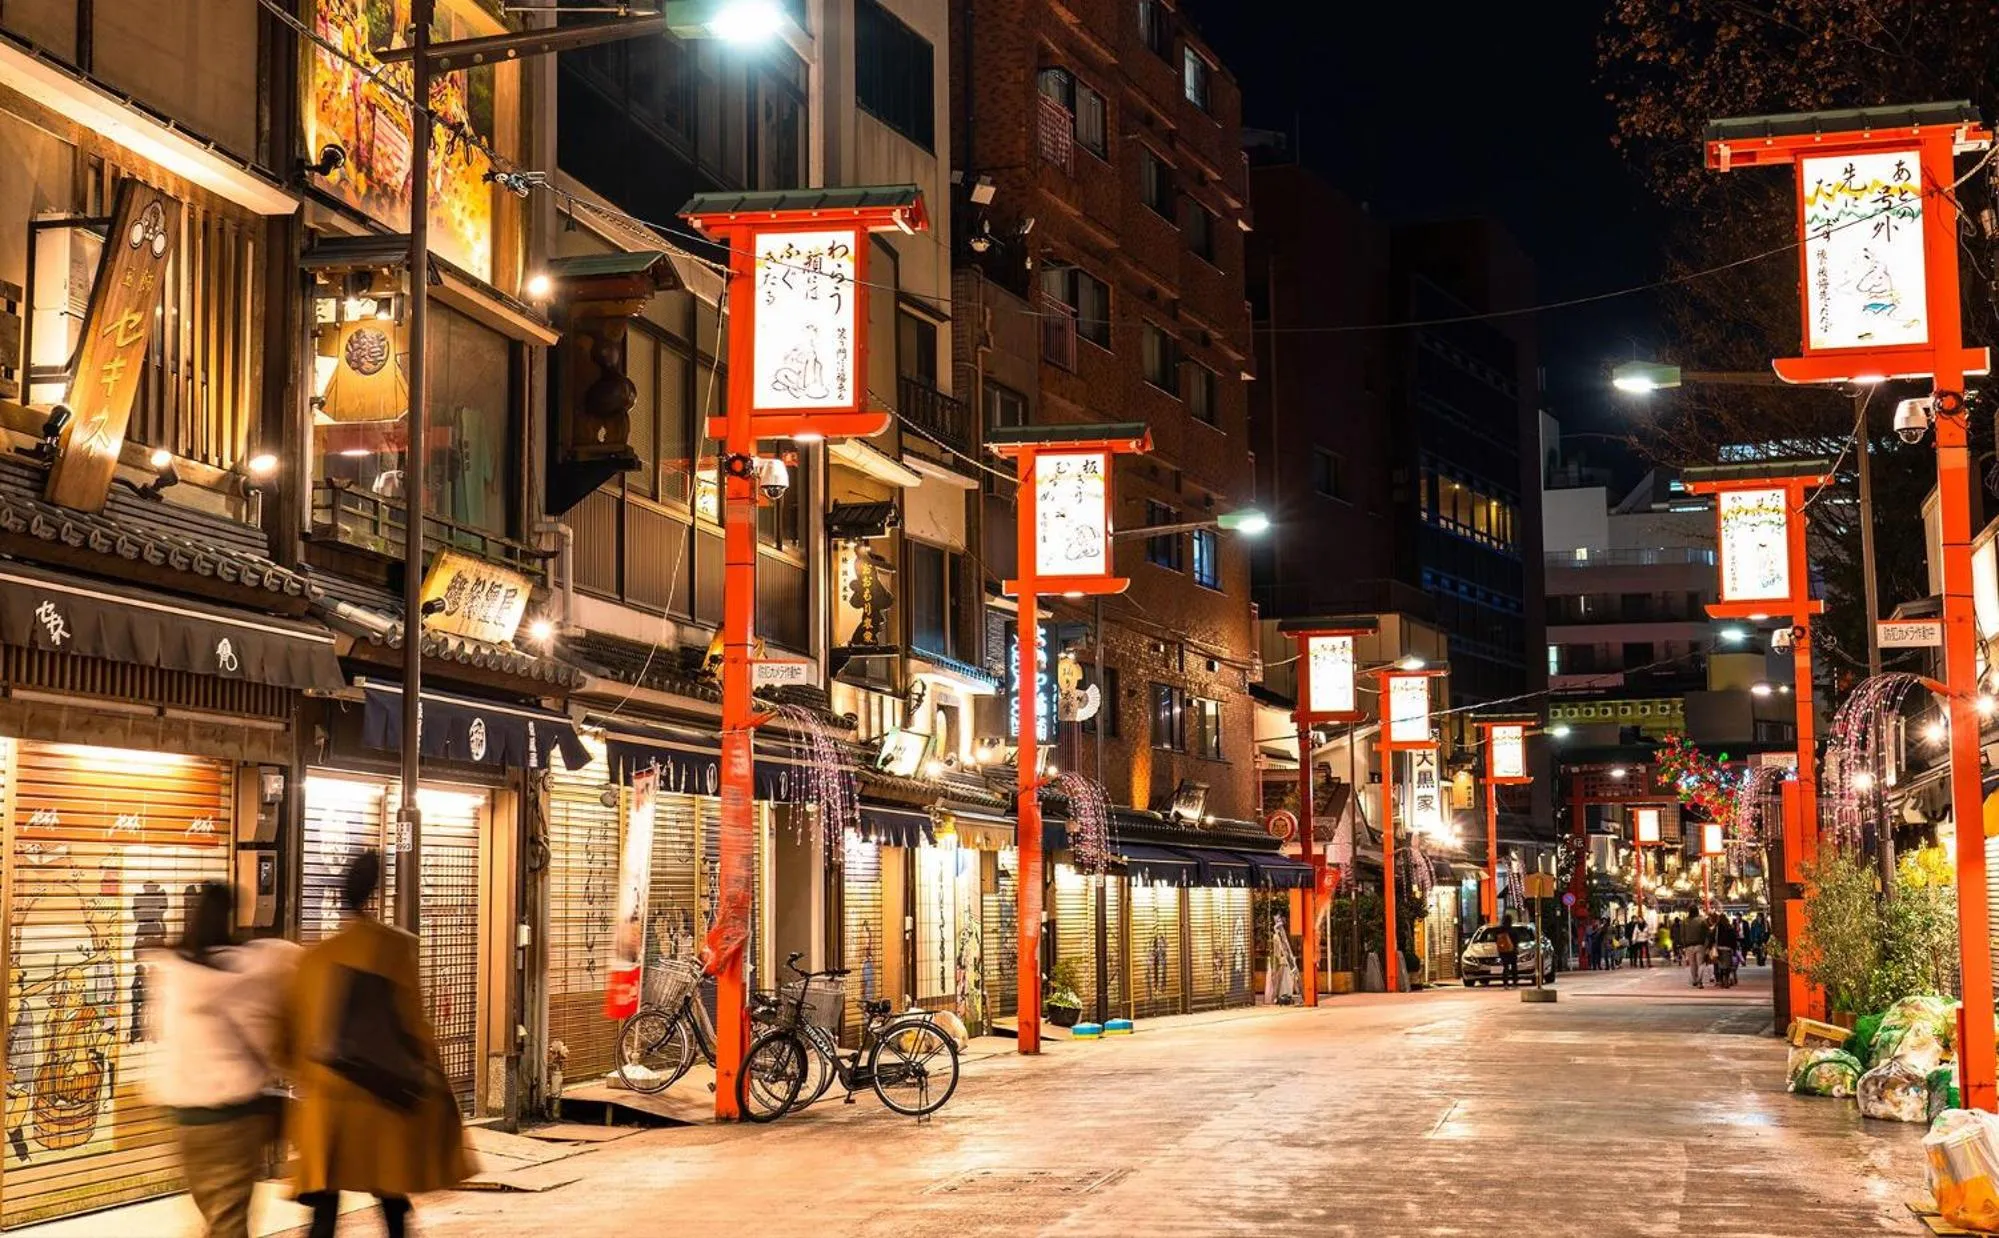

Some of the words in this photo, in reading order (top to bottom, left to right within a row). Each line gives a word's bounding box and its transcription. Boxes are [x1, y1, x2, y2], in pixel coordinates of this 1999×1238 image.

[1838, 162, 1868, 208] 先に
[1871, 184, 1899, 243] 号外
[1892, 159, 1916, 223] あとの
[827, 239, 850, 316] わらう
[81, 306, 146, 461] セキネ
[1416, 750, 1437, 813] 大黒家
